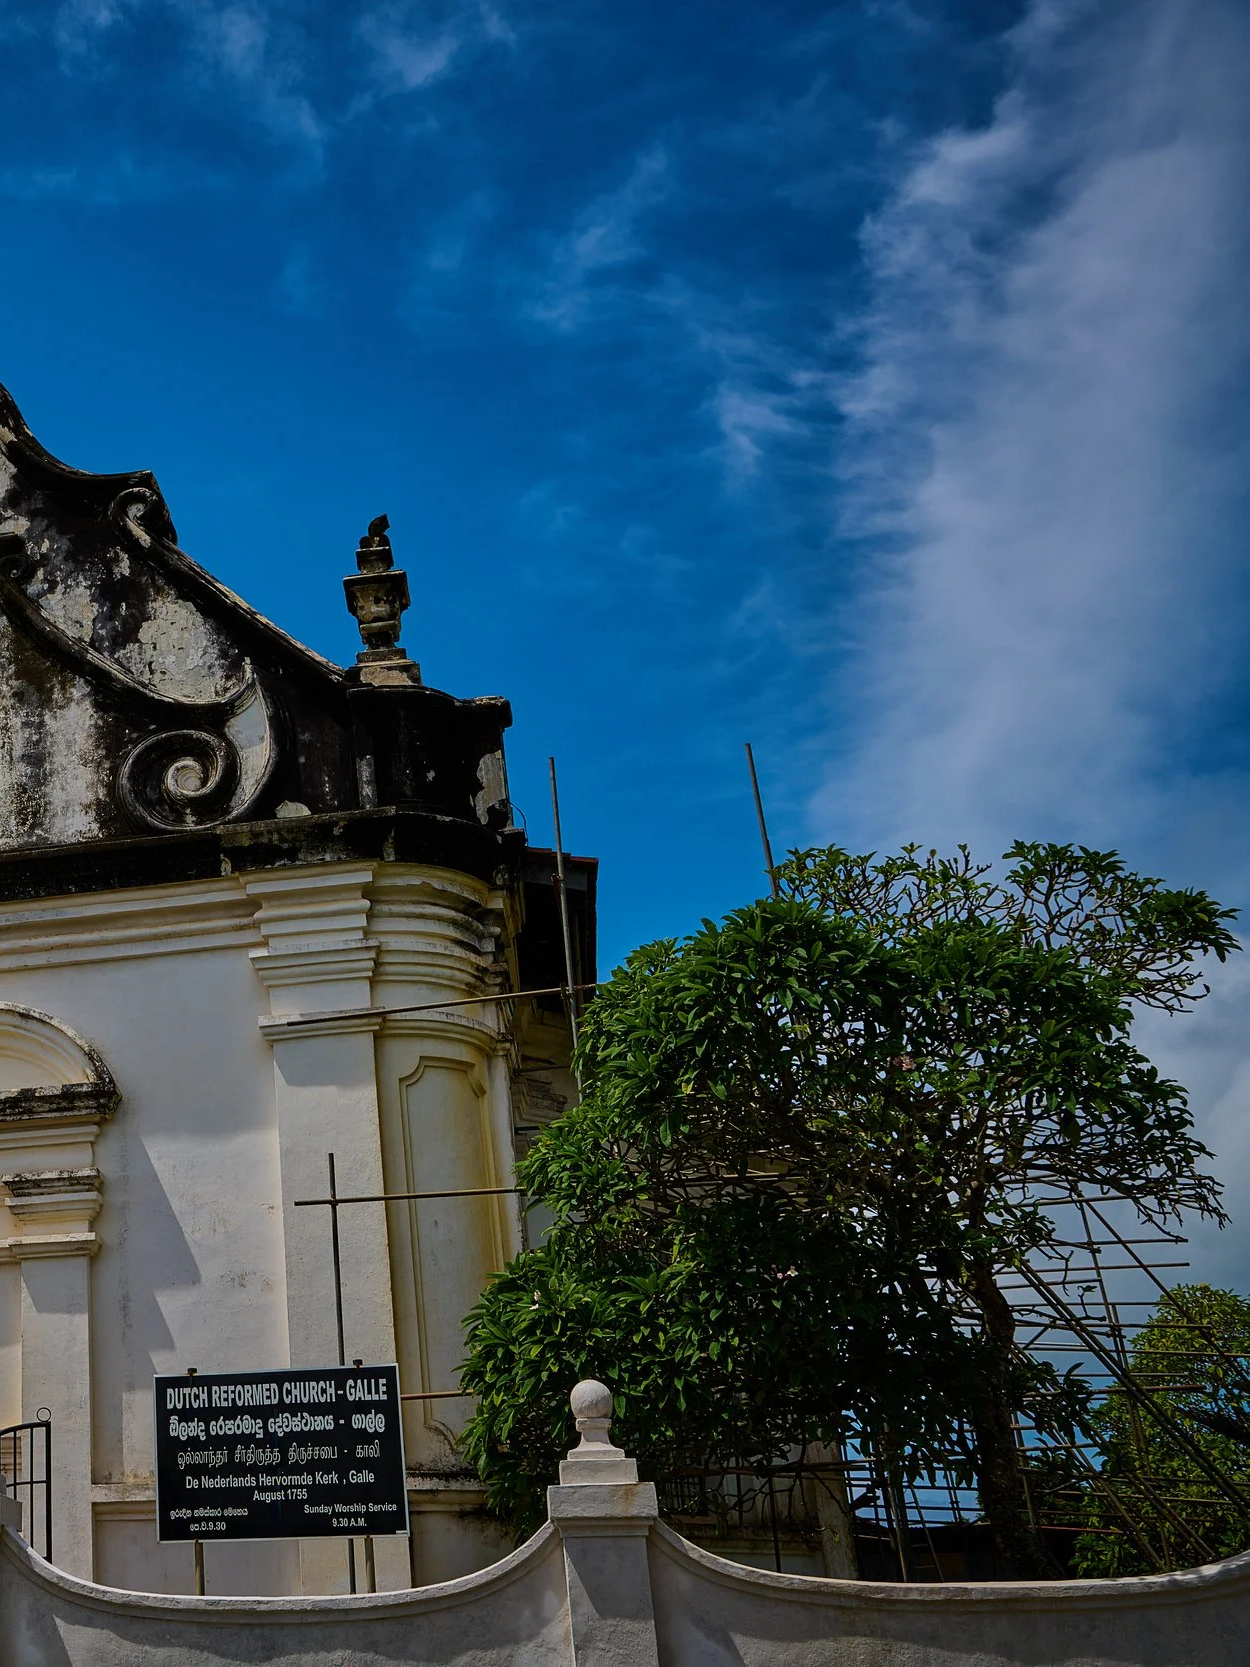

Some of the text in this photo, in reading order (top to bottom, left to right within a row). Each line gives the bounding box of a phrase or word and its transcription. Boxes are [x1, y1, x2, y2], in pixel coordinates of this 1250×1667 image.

[167, 1387, 208, 1409] DUTCH
[212, 1383, 278, 1407] REFORMED
[283, 1381, 335, 1403] CHURCH
[346, 1379, 387, 1401] GALLE
[352, 1410, 385, 1432] ගාල්ල
[178, 1447, 228, 1469] ஒல்லாந்தர்
[235, 1444, 280, 1465] சீர்திருத்த
[288, 1442, 337, 1464] திருச்சபை
[356, 1440, 380, 1457] காலி
[186, 1476, 198, 1488] De
[202, 1474, 256, 1488] Nederlands
[259, 1472, 312, 1486] Hervormde
[316, 1471, 338, 1484] Kerk
[349, 1470, 374, 1483] Galle
[253, 1489, 307, 1503] August 1755
[304, 1503, 396, 1515] Sunday Worship Service
[333, 1518, 366, 1526] 9.30 A.M.
